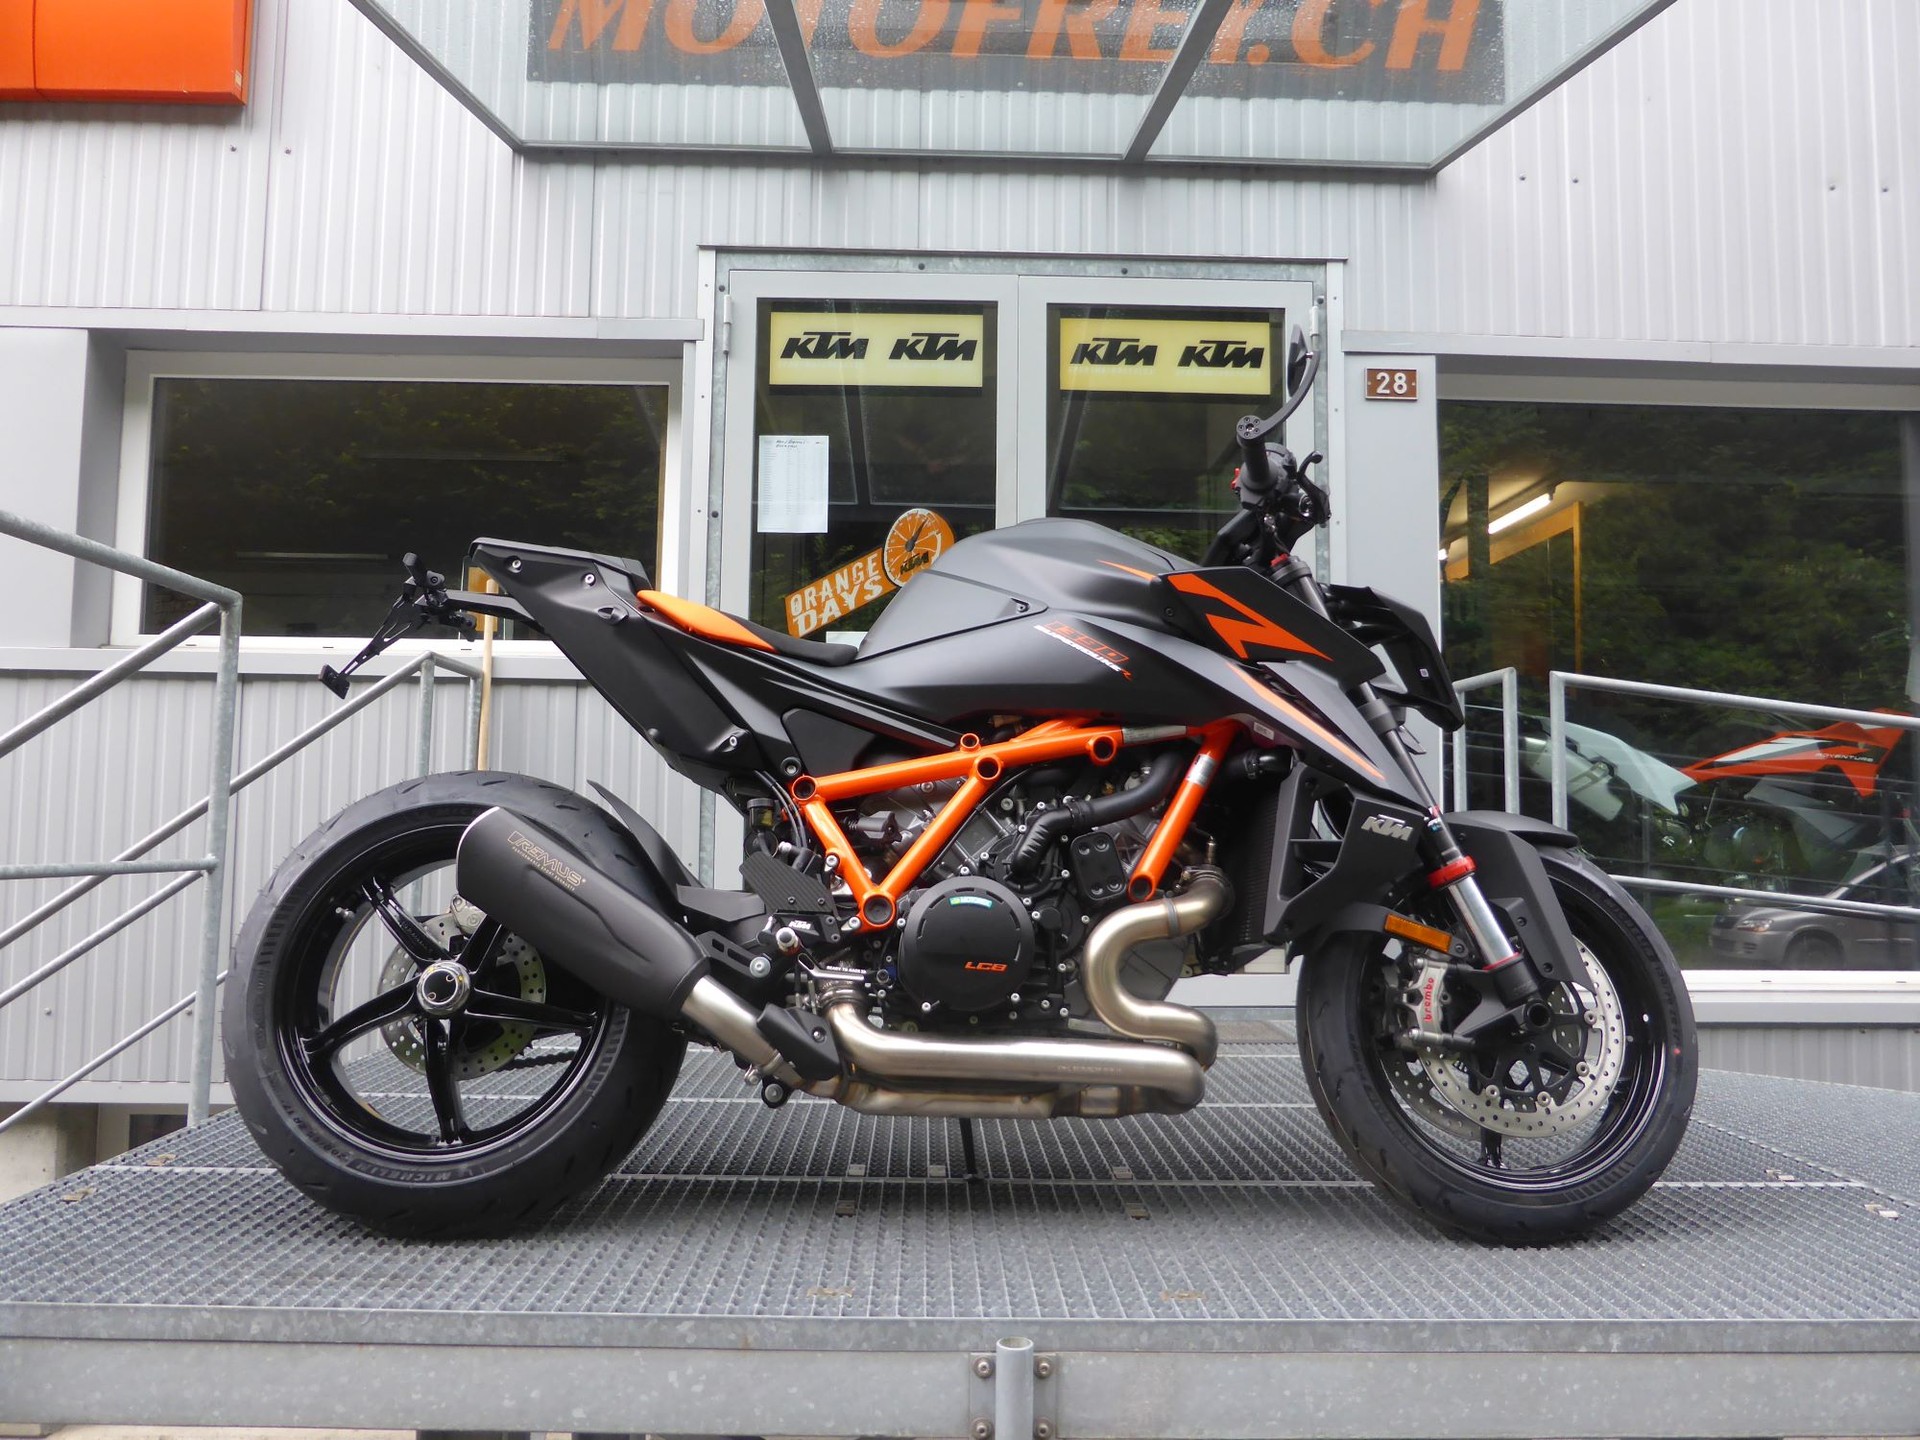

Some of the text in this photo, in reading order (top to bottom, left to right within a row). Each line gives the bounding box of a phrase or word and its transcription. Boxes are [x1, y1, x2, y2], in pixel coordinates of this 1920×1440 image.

[547, 0, 1479, 71] MOOFREY.CH
[780, 331, 978, 361] KTM KTM
[1070, 337, 1265, 368] KTM KTM
[1376, 371, 1407, 395] 28
[901, 551, 929, 575] KTM
[790, 553, 880, 616] ORANGE
[793, 574, 883, 638] DAYS
[1361, 814, 1413, 841] KTM
[514, 836, 582, 887] REMUS
[965, 961, 1008, 972] LC8
[1423, 977, 1435, 1023] brembo
[354, 1160, 453, 1182] MICHELIN
